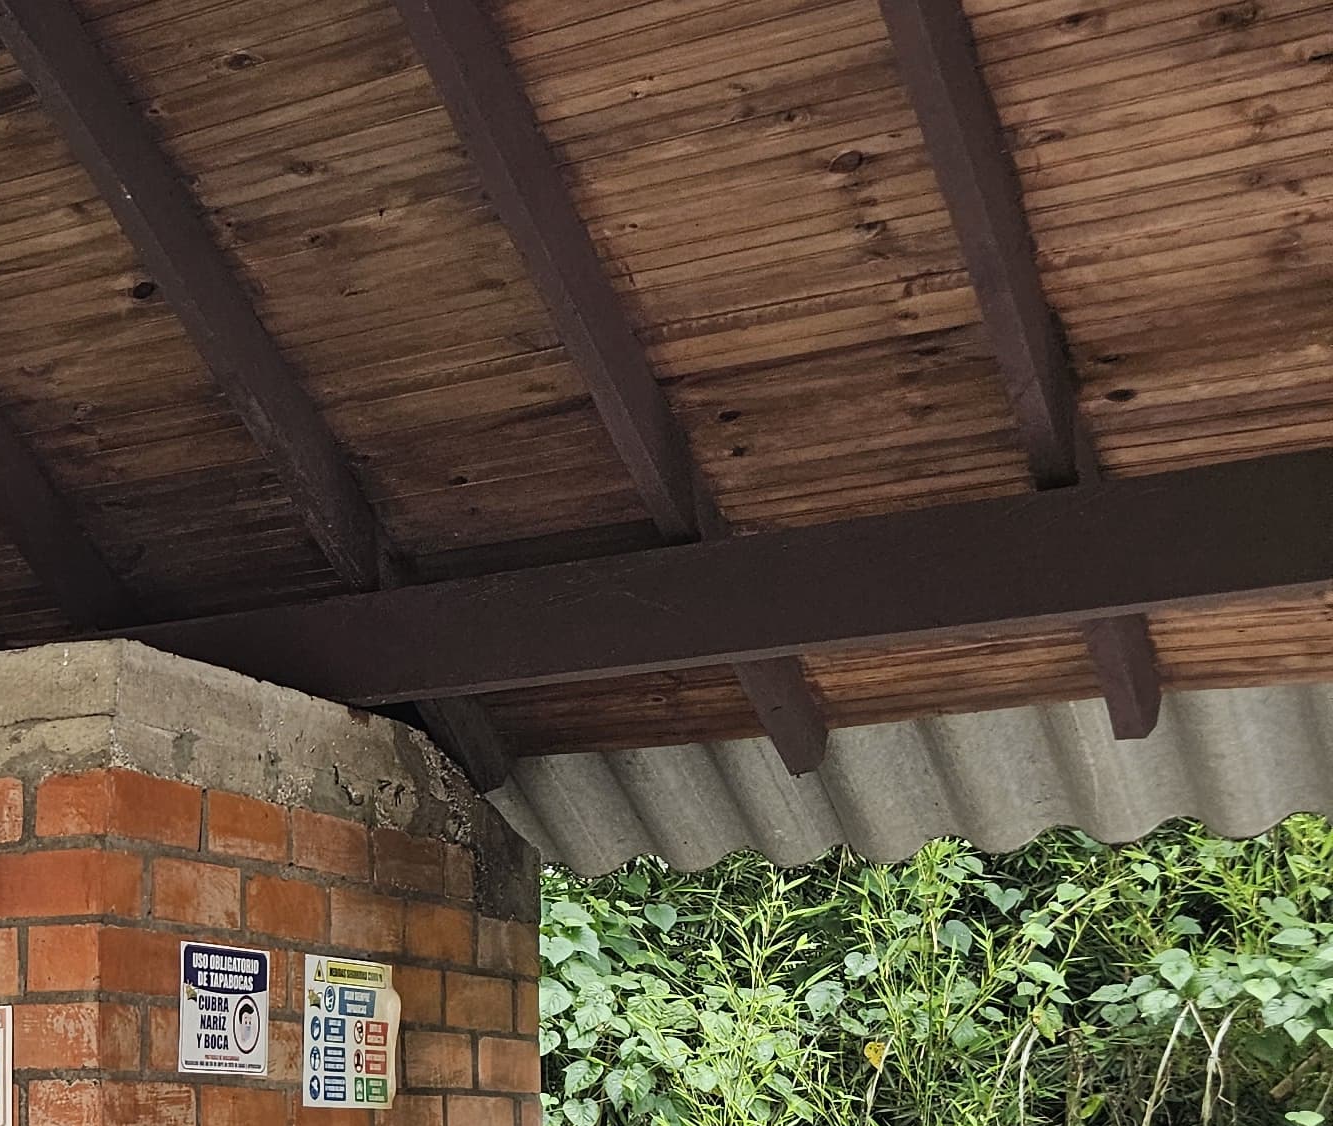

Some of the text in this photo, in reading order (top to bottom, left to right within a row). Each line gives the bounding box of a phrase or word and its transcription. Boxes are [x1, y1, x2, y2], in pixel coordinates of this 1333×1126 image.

[192, 952, 260, 975] USO OBLIGATORIO
[197, 971, 254, 991] DE TAPABOCAS
[198, 994, 229, 1013] CUBRA
[200, 1012, 227, 1031] NARÍZ
[196, 1033, 229, 1050] Y BOCA
